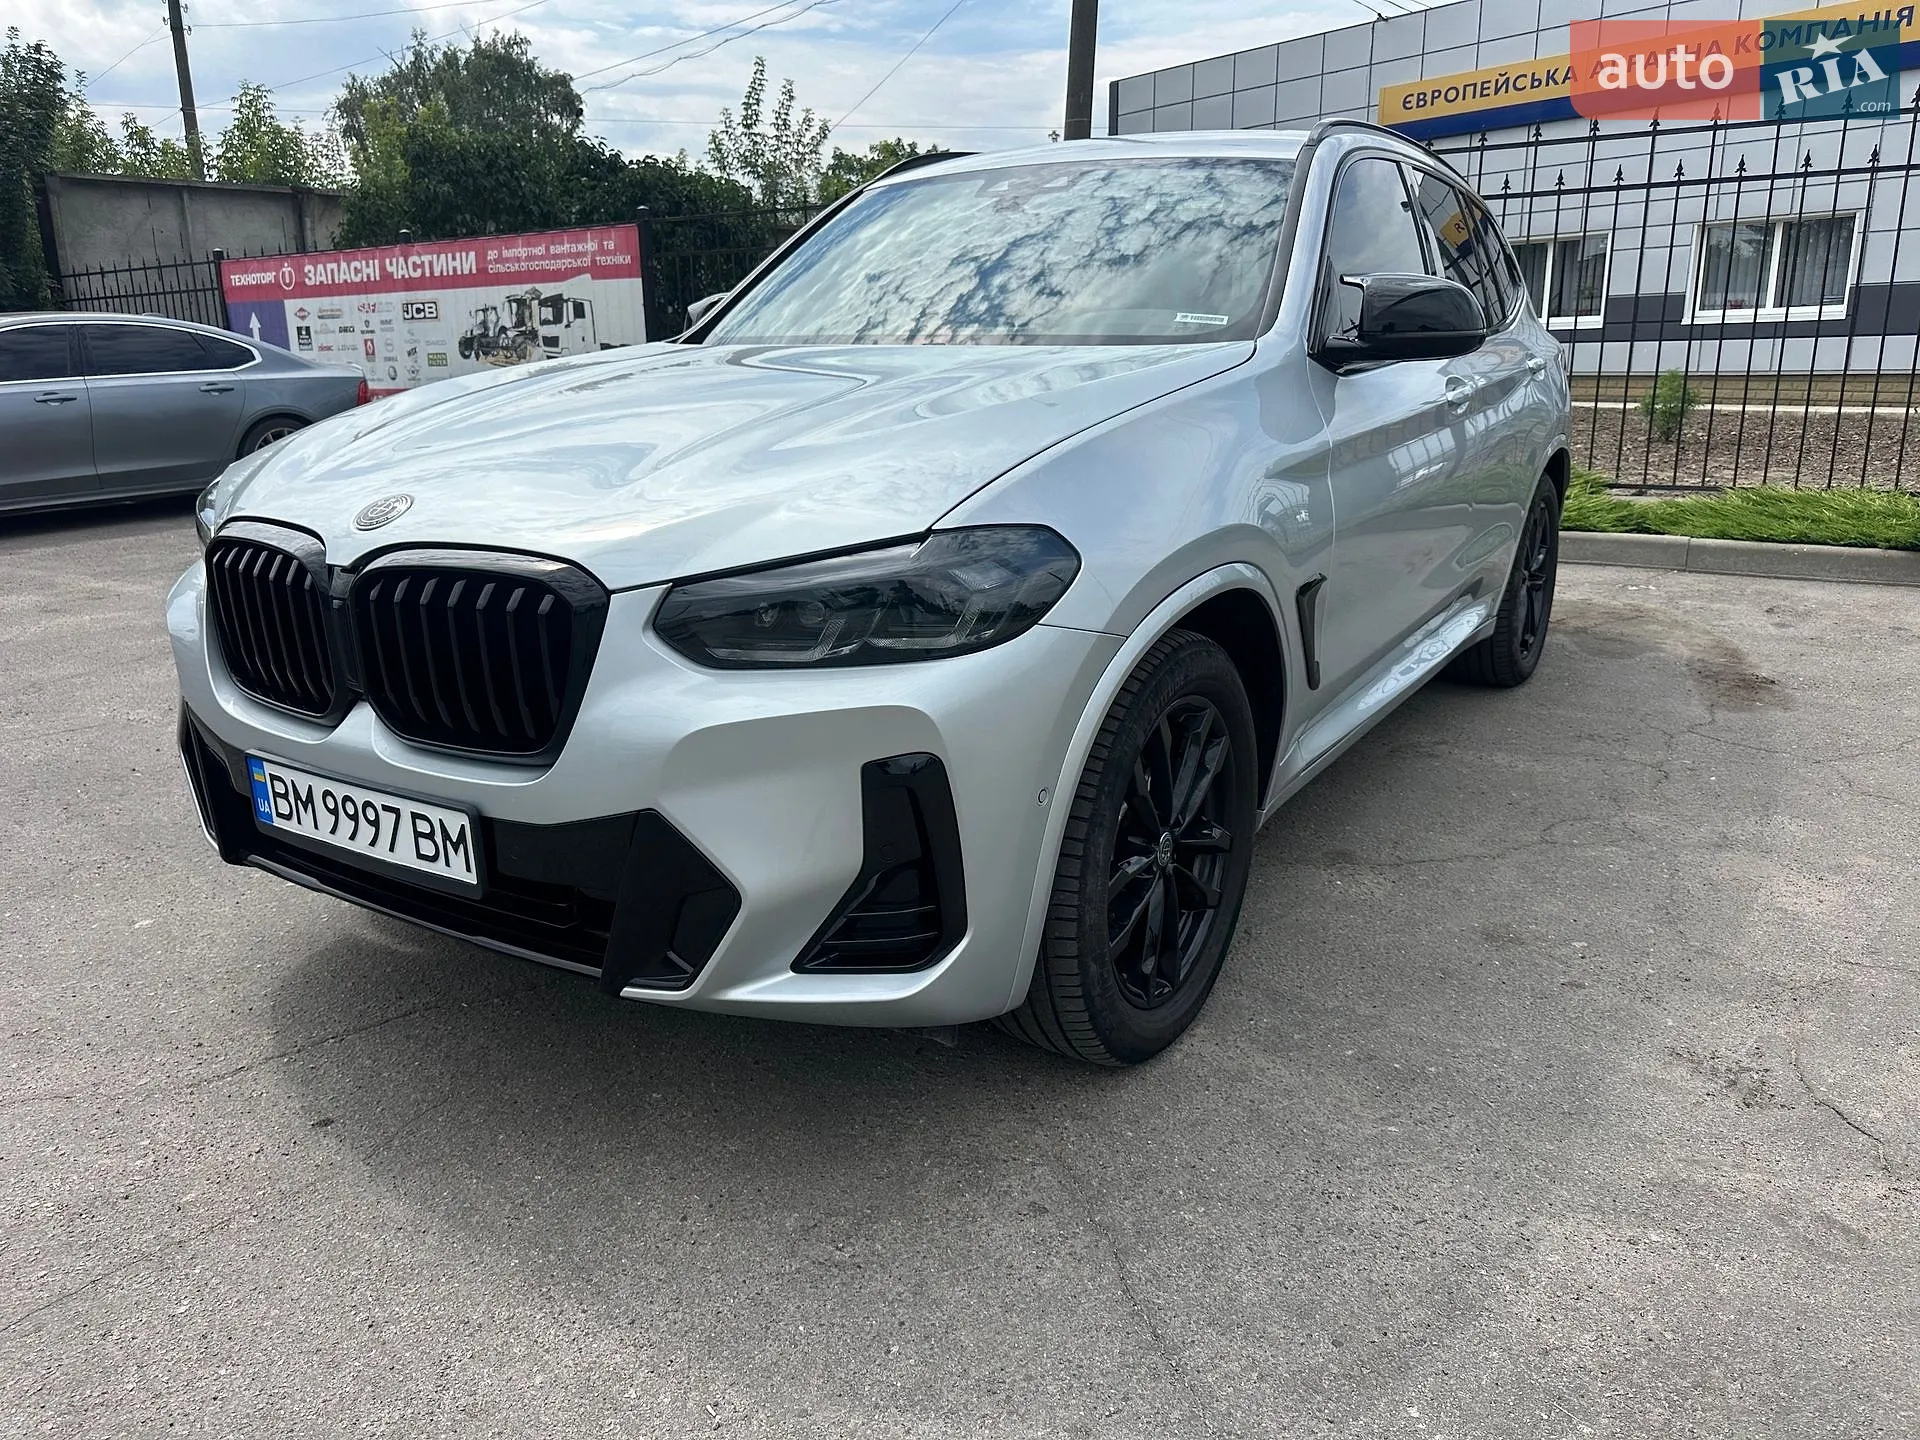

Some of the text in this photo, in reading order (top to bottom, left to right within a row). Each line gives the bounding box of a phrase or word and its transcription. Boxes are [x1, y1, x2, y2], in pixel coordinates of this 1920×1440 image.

[1402, 65, 1578, 111] ЄВРОПЕЙСЬКА
[1734, 5, 1915, 55] КОМПАНІЯ
[487, 239, 615, 261] до імпортної вантажної та
[304, 251, 477, 286] ЗАПАСНІ ЧАСТИНИ
[488, 253, 631, 274] сільськогосподарської техніки
[230, 272, 277, 286] ТЕХНОТОРГ
[404, 303, 437, 319] JCB
[258, 798, 271, 815] UA
[269, 773, 472, 873] BM 9997 BM
